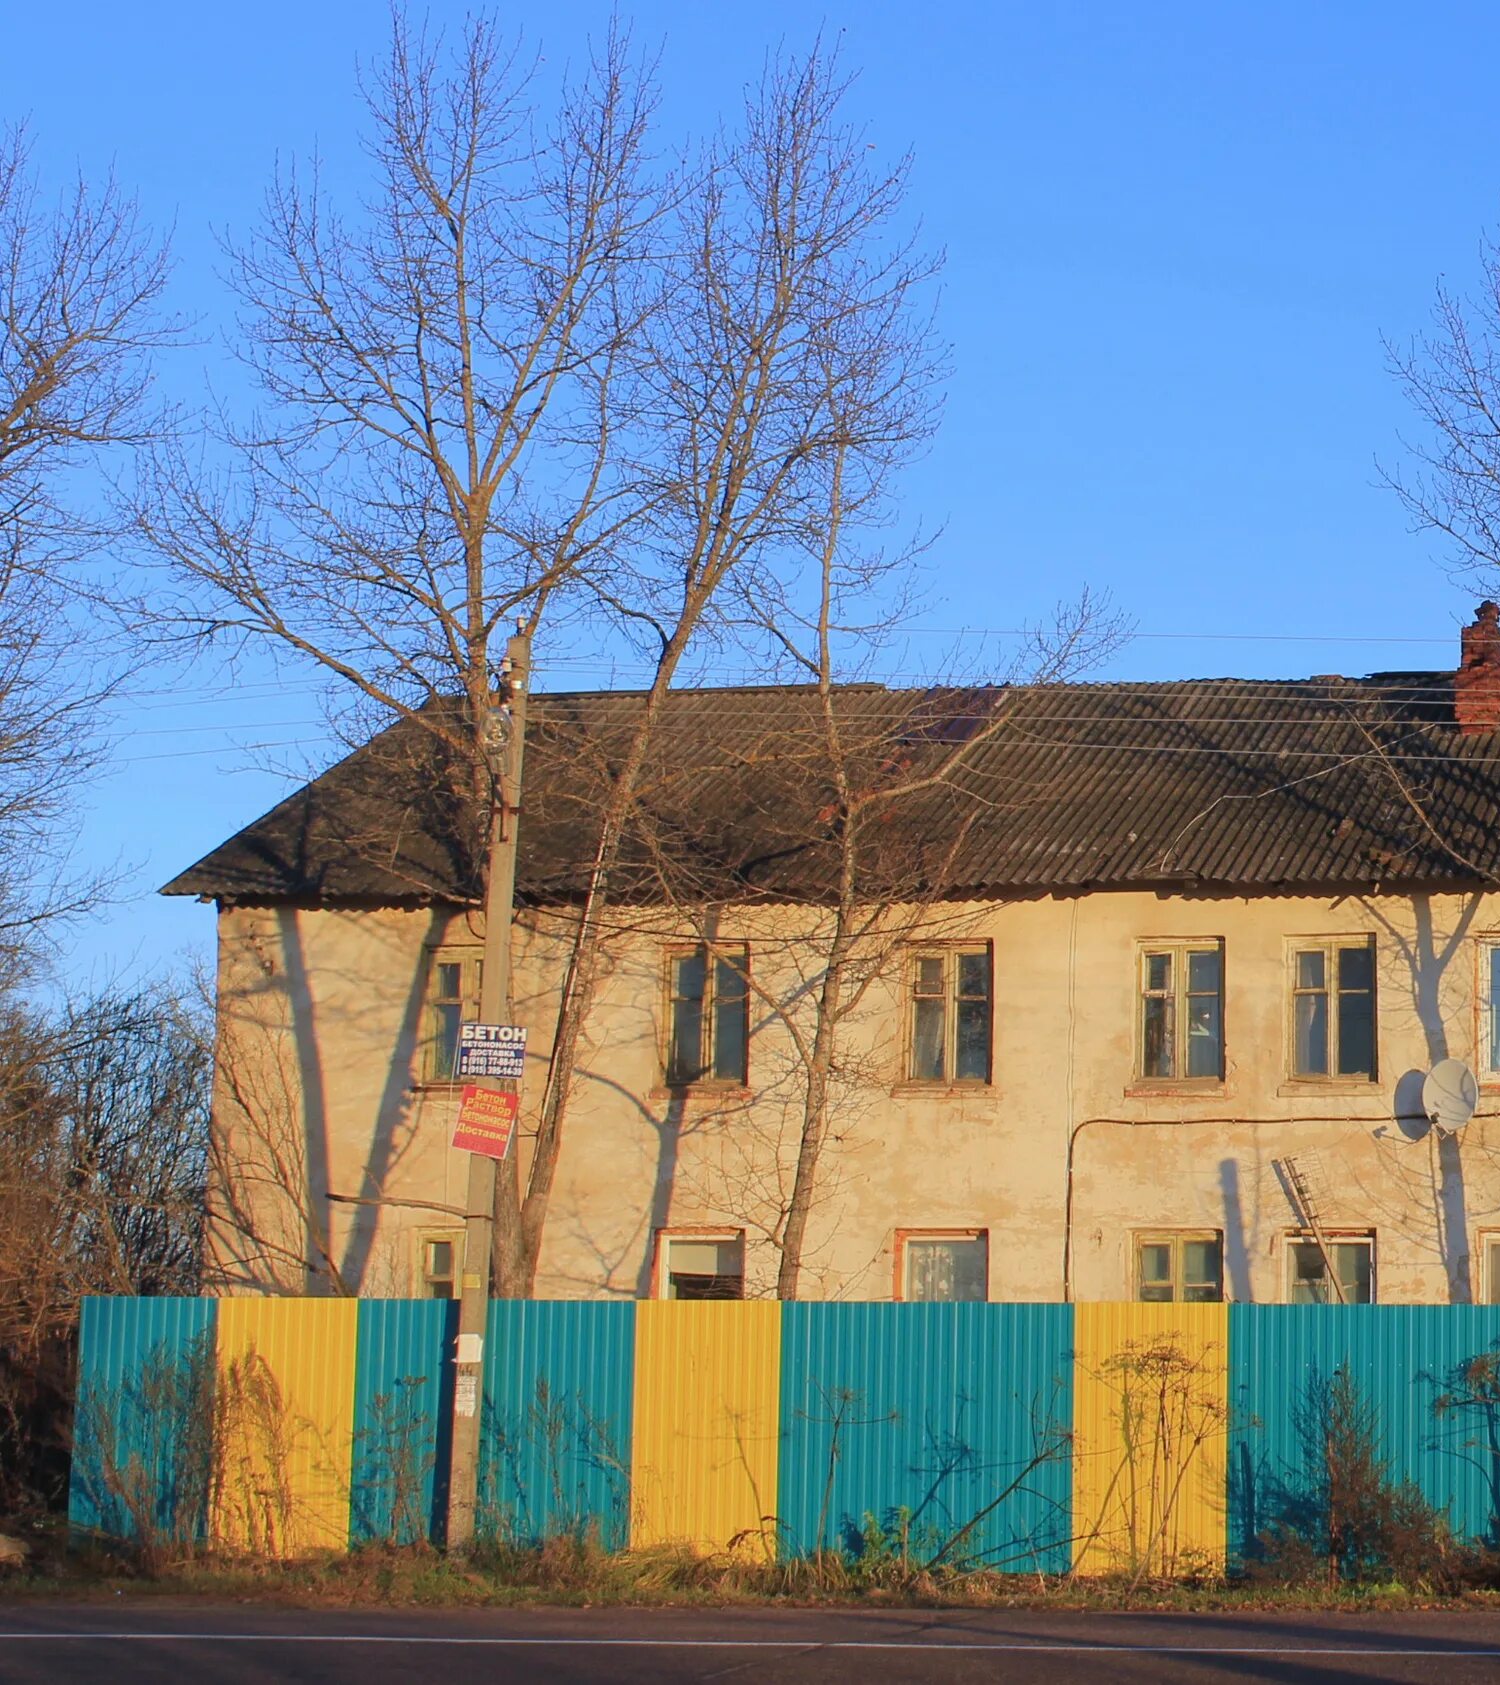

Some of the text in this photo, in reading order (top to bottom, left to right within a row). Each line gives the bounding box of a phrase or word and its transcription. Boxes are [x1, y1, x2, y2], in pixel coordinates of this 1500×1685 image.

[462, 1025, 527, 1041] БЕТОН
[461, 1041, 525, 1050] БЕТОНОНАСОС
[469, 1049, 515, 1057] ДОСТАВКА
[461, 1056, 468, 1064] 8
[461, 1065, 467, 1073] 8
[468, 1065, 486, 1075] (915)
[475, 1089, 507, 1105] Бетон
[466, 1097, 512, 1117] Раствор
[457, 1122, 507, 1142] Доставка
